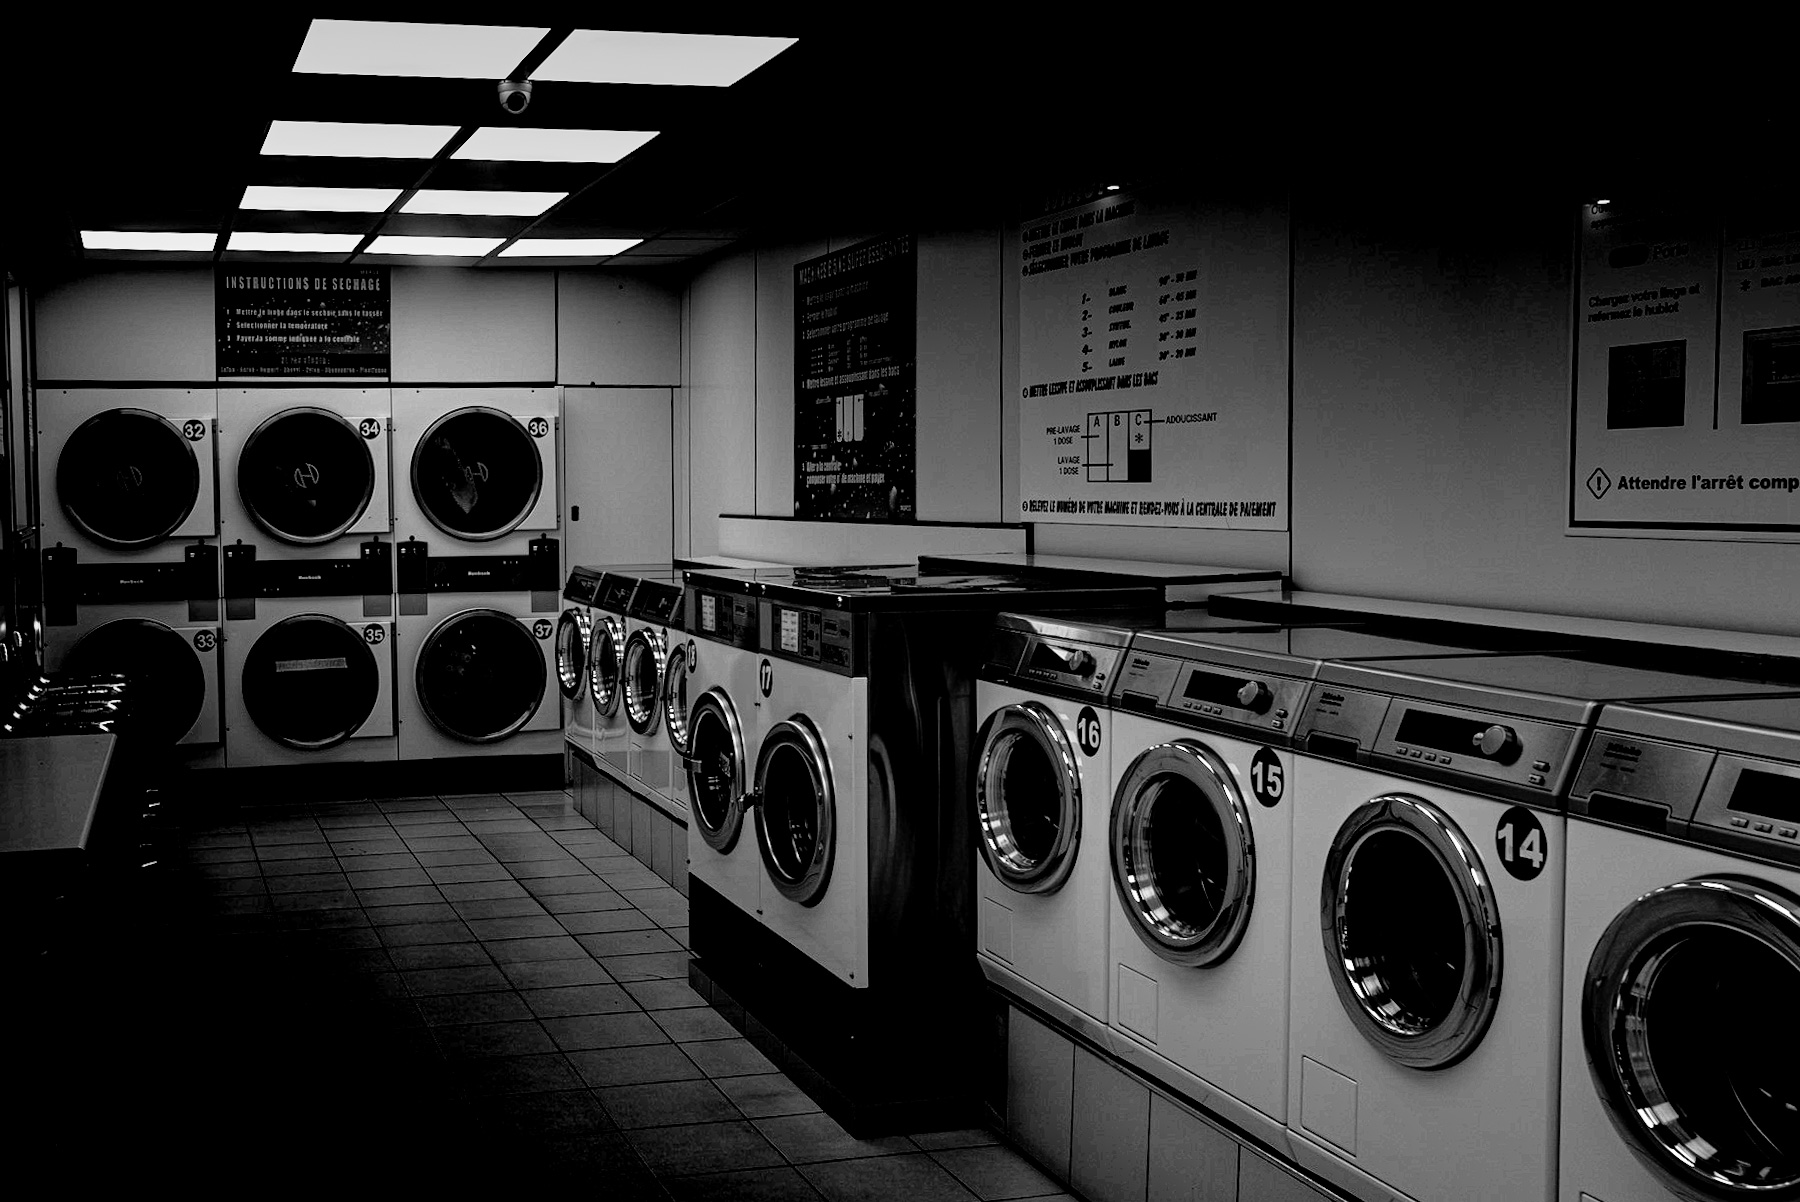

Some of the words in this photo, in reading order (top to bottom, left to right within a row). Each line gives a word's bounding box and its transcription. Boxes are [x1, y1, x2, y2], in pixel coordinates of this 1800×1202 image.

[225, 275, 310, 291] INSTRUCTIONS
[314, 277, 328, 291] DE
[332, 277, 381, 292] SECHAGE
[1588, 295, 1629, 307] Chargez
[1631, 290, 1658, 302] votre
[1660, 286, 1686, 299] linge
[1688, 283, 1700, 295] et
[1587, 310, 1631, 322] refermez
[1633, 306, 1643, 317] le
[1645, 302, 1679, 316] hublot
[279, 321, 287, 330] la
[1068, 379, 1076, 393] ET
[1132, 372, 1142, 387] LES
[1094, 416, 1101, 427] A
[1114, 414, 1121, 427] B
[1135, 413, 1142, 426] C
[1165, 412, 1218, 425] ADOUCISSANT
[185, 423, 204, 438] 32
[361, 421, 380, 436] 34
[529, 421, 548, 436] 36
[1058, 437, 1073, 445] DOSE
[1057, 456, 1080, 464] LAVAGE
[1063, 467, 1079, 475] DOSE
[1617, 475, 1686, 490] Attendre
[1692, 474, 1744, 490] l'arrêt
[1749, 477, 1800, 492] comp
[1049, 500, 1056, 513] LE
[1078, 500, 1086, 514] DE
[1130, 501, 1138, 514] ET
[1186, 501, 1194, 515] LA
[1195, 501, 1228, 517] CENTRALE
[1228, 501, 1239, 517] DE
[366, 629, 384, 642] 35
[535, 624, 552, 637] 37
[196, 634, 215, 648] 33
[761, 664, 772, 690] 17
[1078, 717, 1100, 748] 16
[1252, 761, 1281, 798] 15
[1497, 822, 1544, 869] 14
